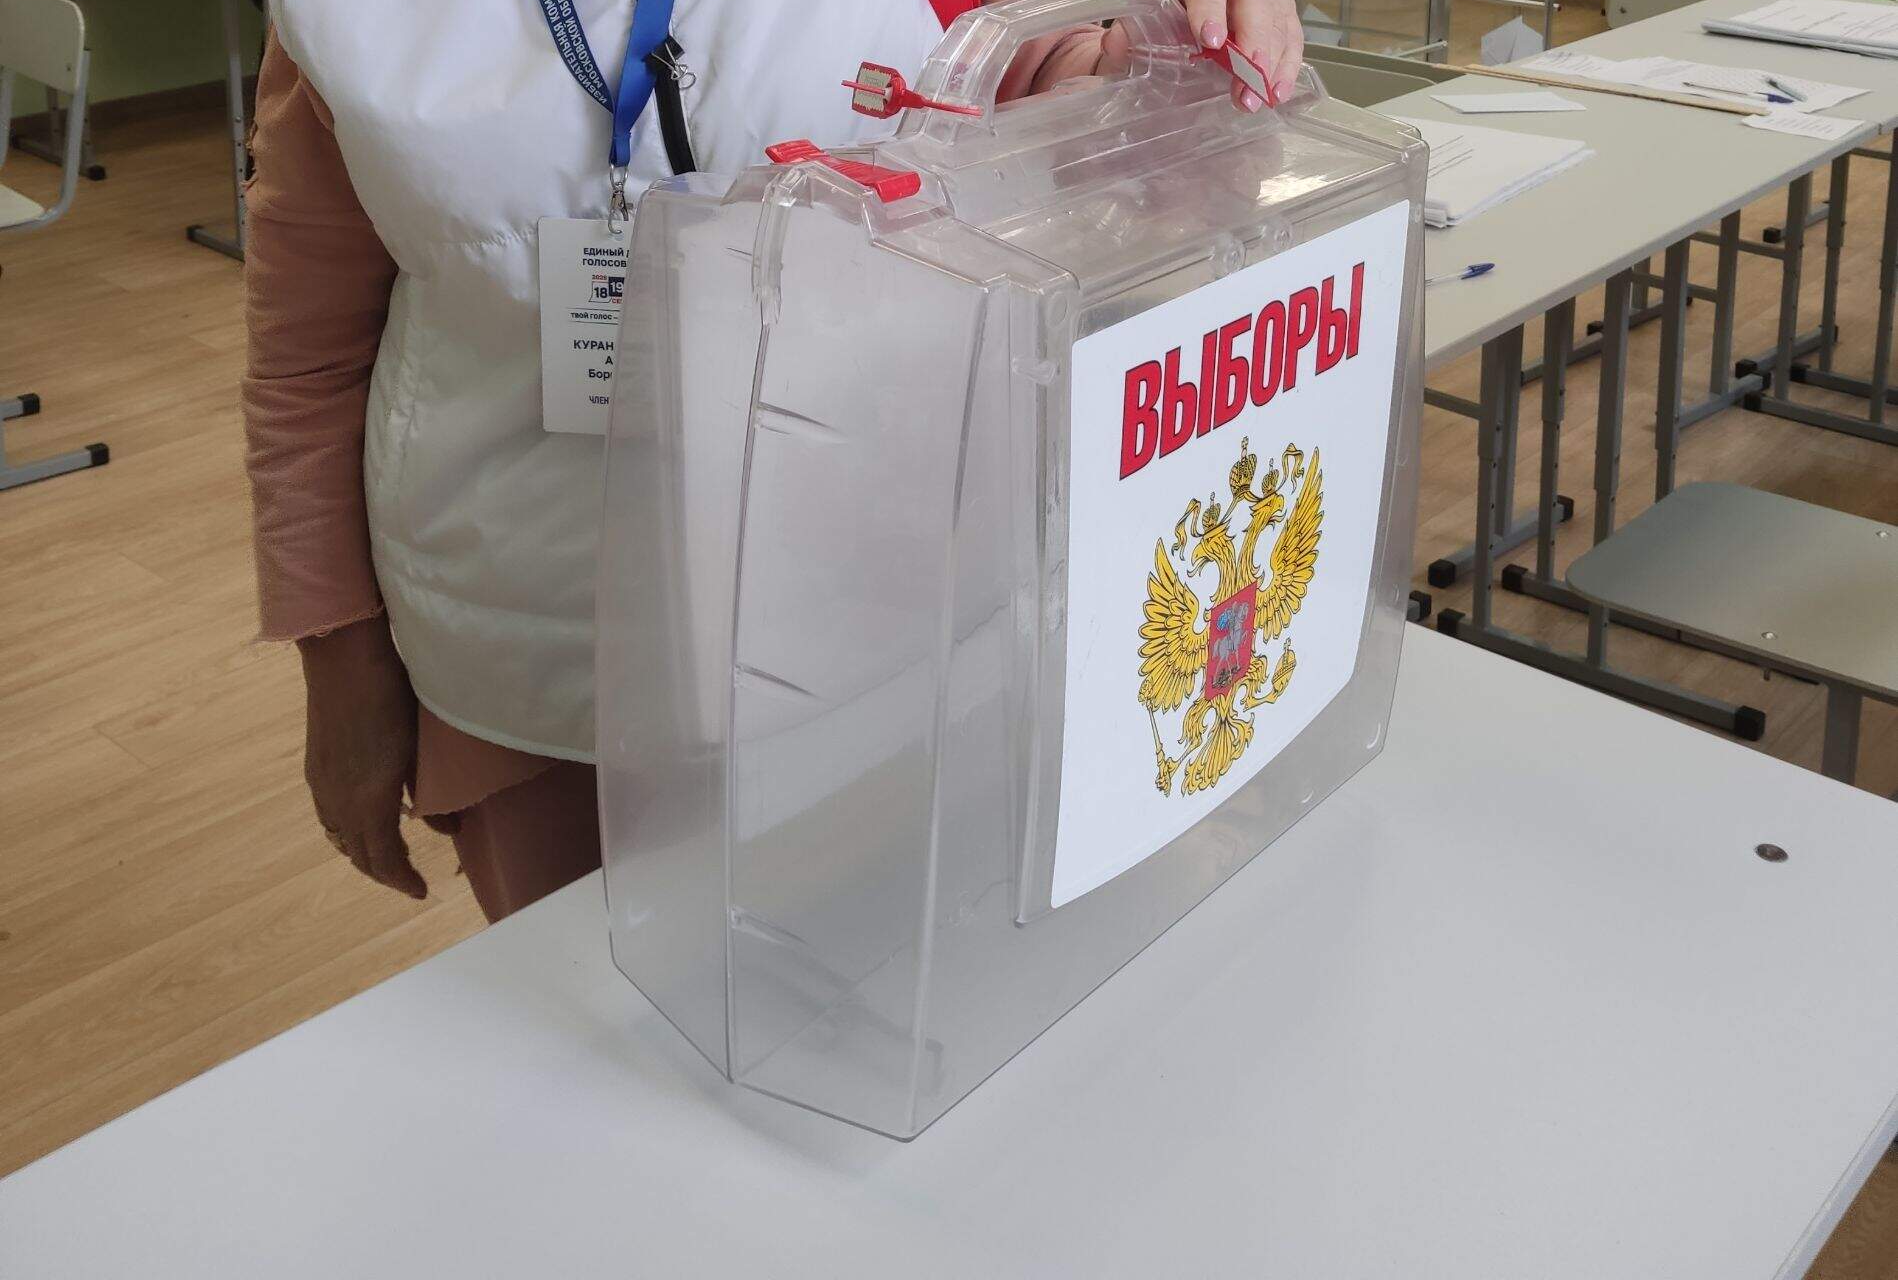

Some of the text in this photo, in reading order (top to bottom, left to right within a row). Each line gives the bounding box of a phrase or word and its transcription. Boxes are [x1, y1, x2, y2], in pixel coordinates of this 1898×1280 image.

[563, 20, 603, 89] МОСКОВСКОЙ
[553, 23, 607, 104] ИЗБИРАТЕЛЬНАЯ
[583, 247, 624, 257] ЕДИНЫЙ
[582, 258, 627, 268] ГОЛОСОВ
[593, 286, 608, 299] 18
[610, 281, 624, 293] 19
[571, 312, 589, 320] ТВОЙ
[573, 339, 614, 351] КУРАН
[588, 368, 613, 381] Бор
[1119, 261, 1366, 481] ВЫБОРЫ
[588, 395, 610, 405] ЧЛЕН
